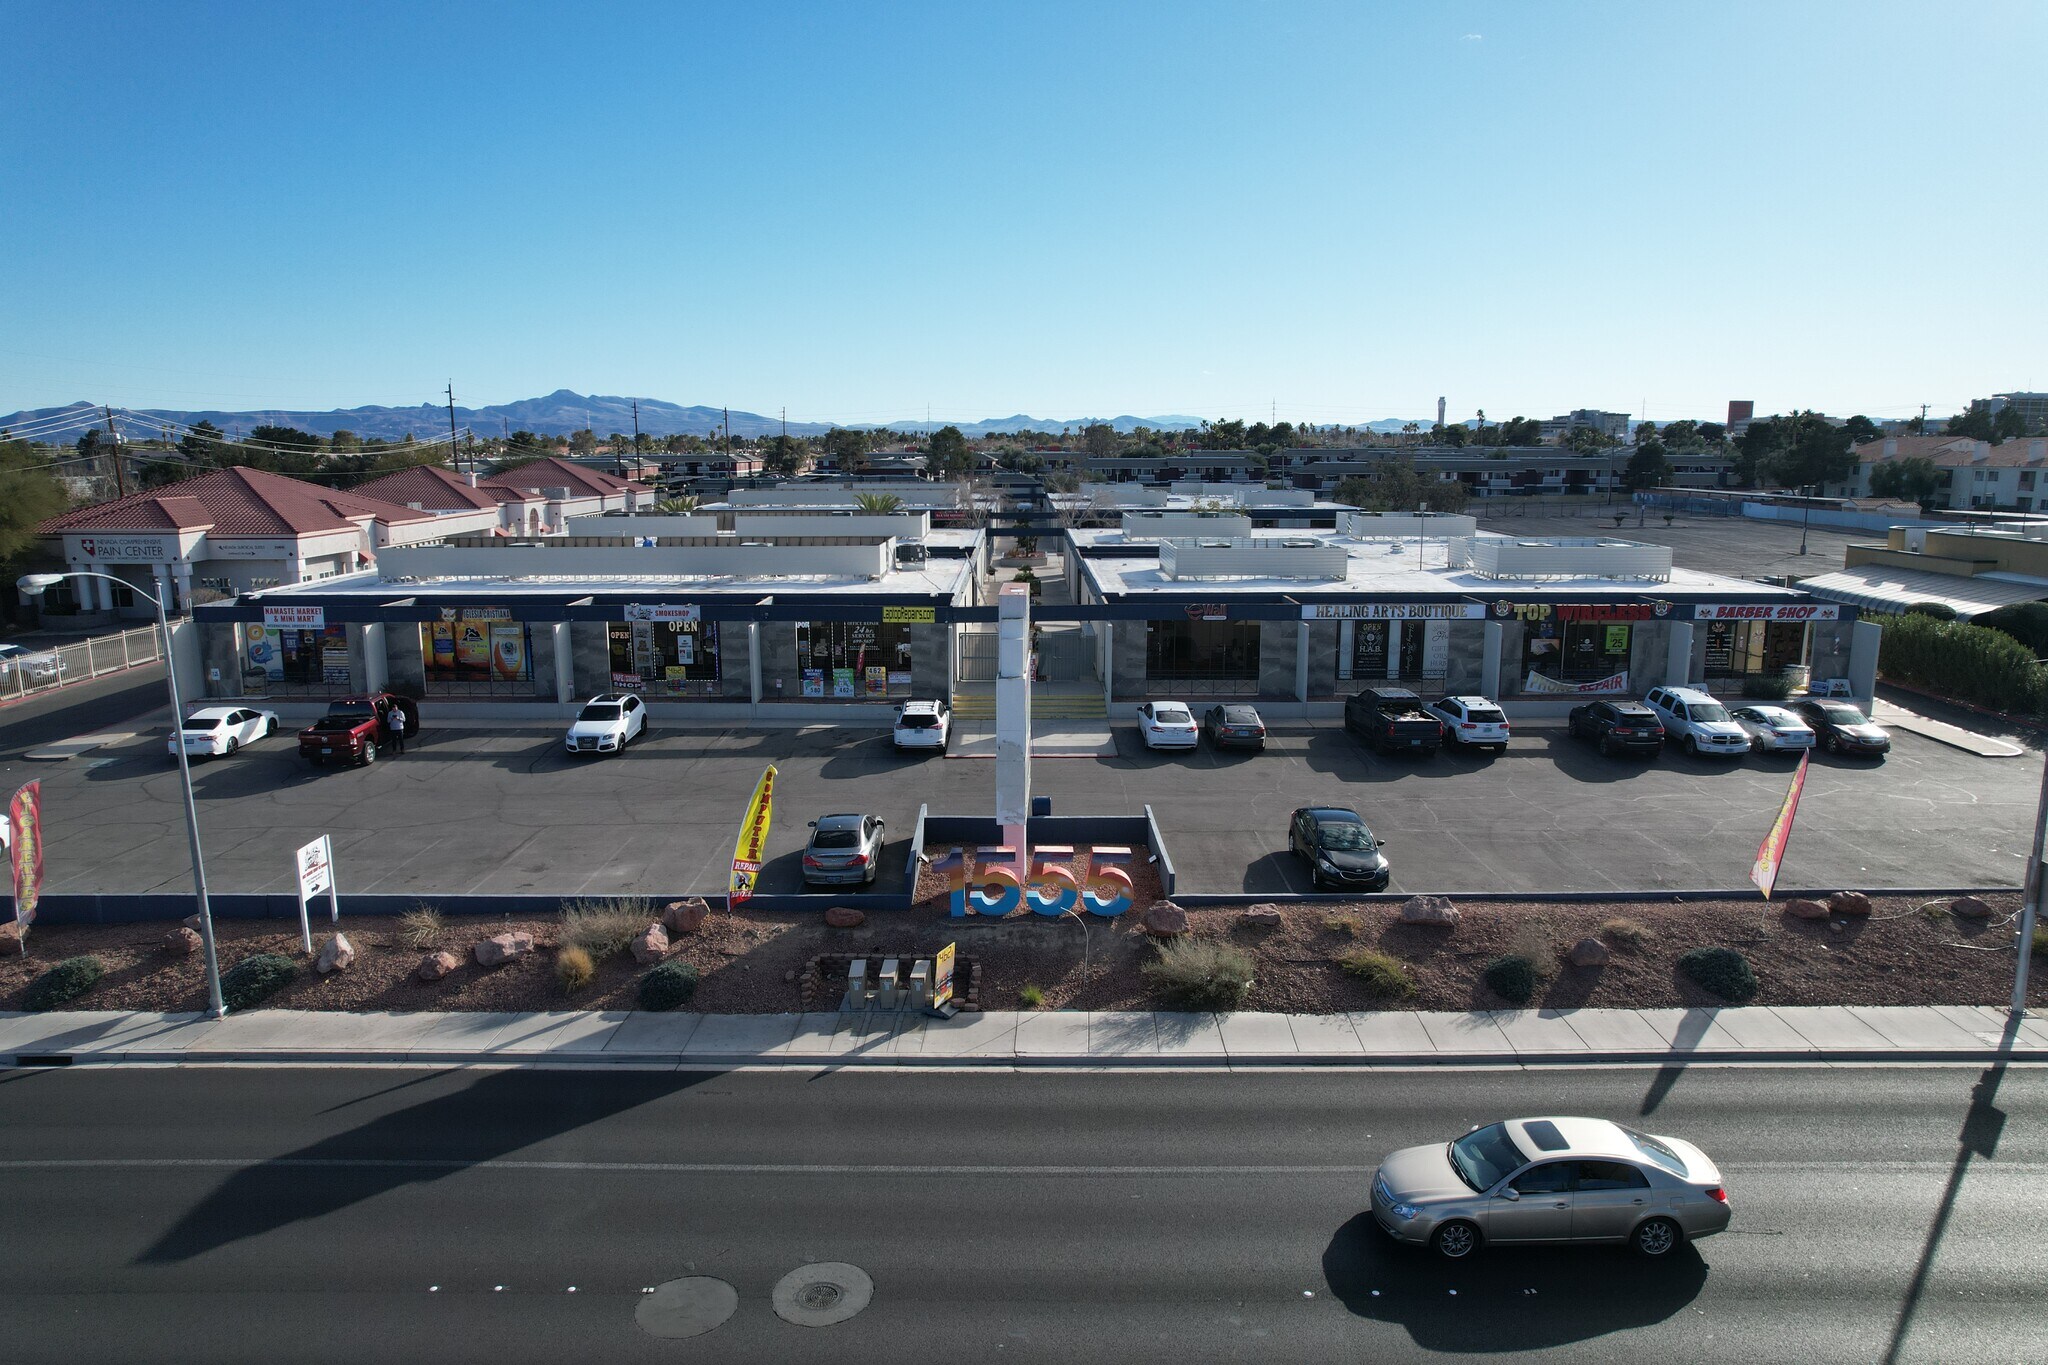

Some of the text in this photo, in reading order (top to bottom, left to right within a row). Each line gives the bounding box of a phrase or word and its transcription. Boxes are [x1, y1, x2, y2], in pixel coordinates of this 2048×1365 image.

[98, 546, 164, 556] PAIN CENTER
[265, 607, 322, 615] NAMASTE MARKET
[654, 609, 690, 617] SMOKESHOP
[883, 606, 935, 622] LaptopRepairs.com
[1315, 604, 1468, 620] HEALING ARTS BOUTIQUE
[1513, 603, 1651, 621] TOP WIRELESS
[1716, 606, 1818, 618] BARBER SHOP
[273, 615, 279, 623] &
[668, 620, 698, 632] OPEN
[746, 771, 773, 860] COMPUTER
[734, 861, 761, 872] REPAIR
[931, 845, 1134, 918] 1555
